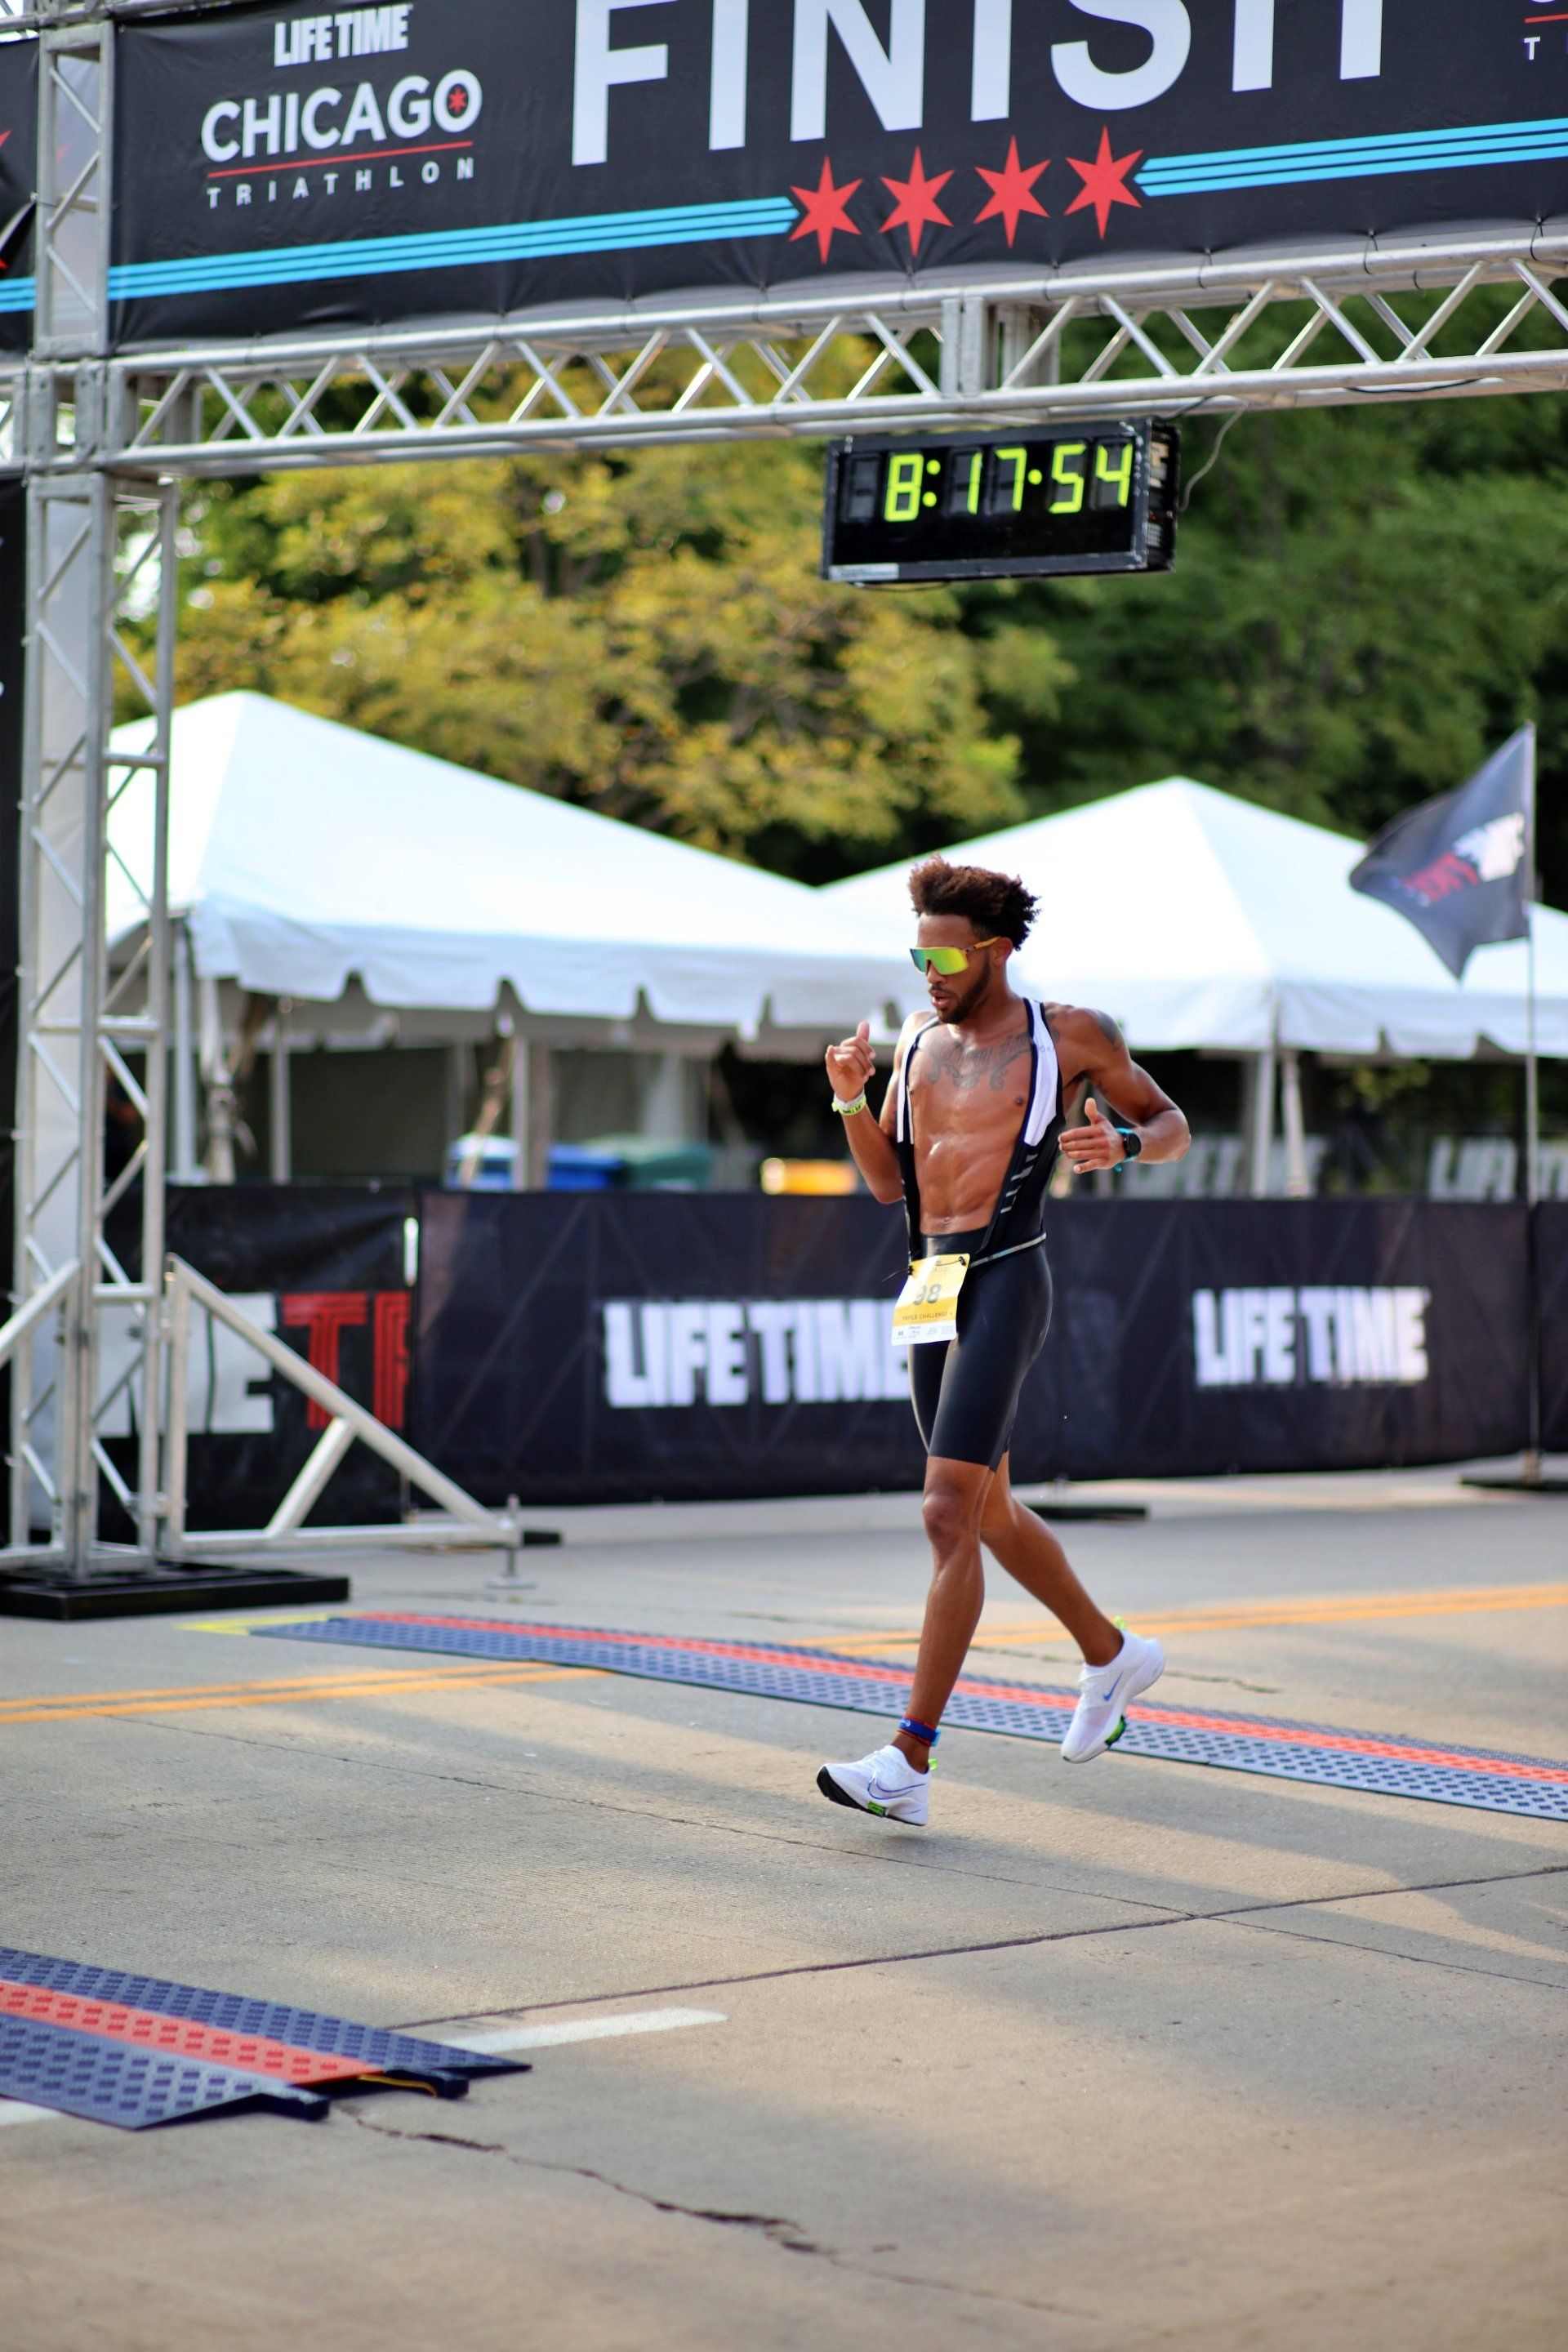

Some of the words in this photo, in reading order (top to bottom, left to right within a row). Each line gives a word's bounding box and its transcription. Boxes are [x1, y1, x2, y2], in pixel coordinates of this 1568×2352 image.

[201, 69, 483, 163] CHICAGO
[207, 158, 474, 210] TRIATHLON
[912, 1282, 942, 1306] 98
